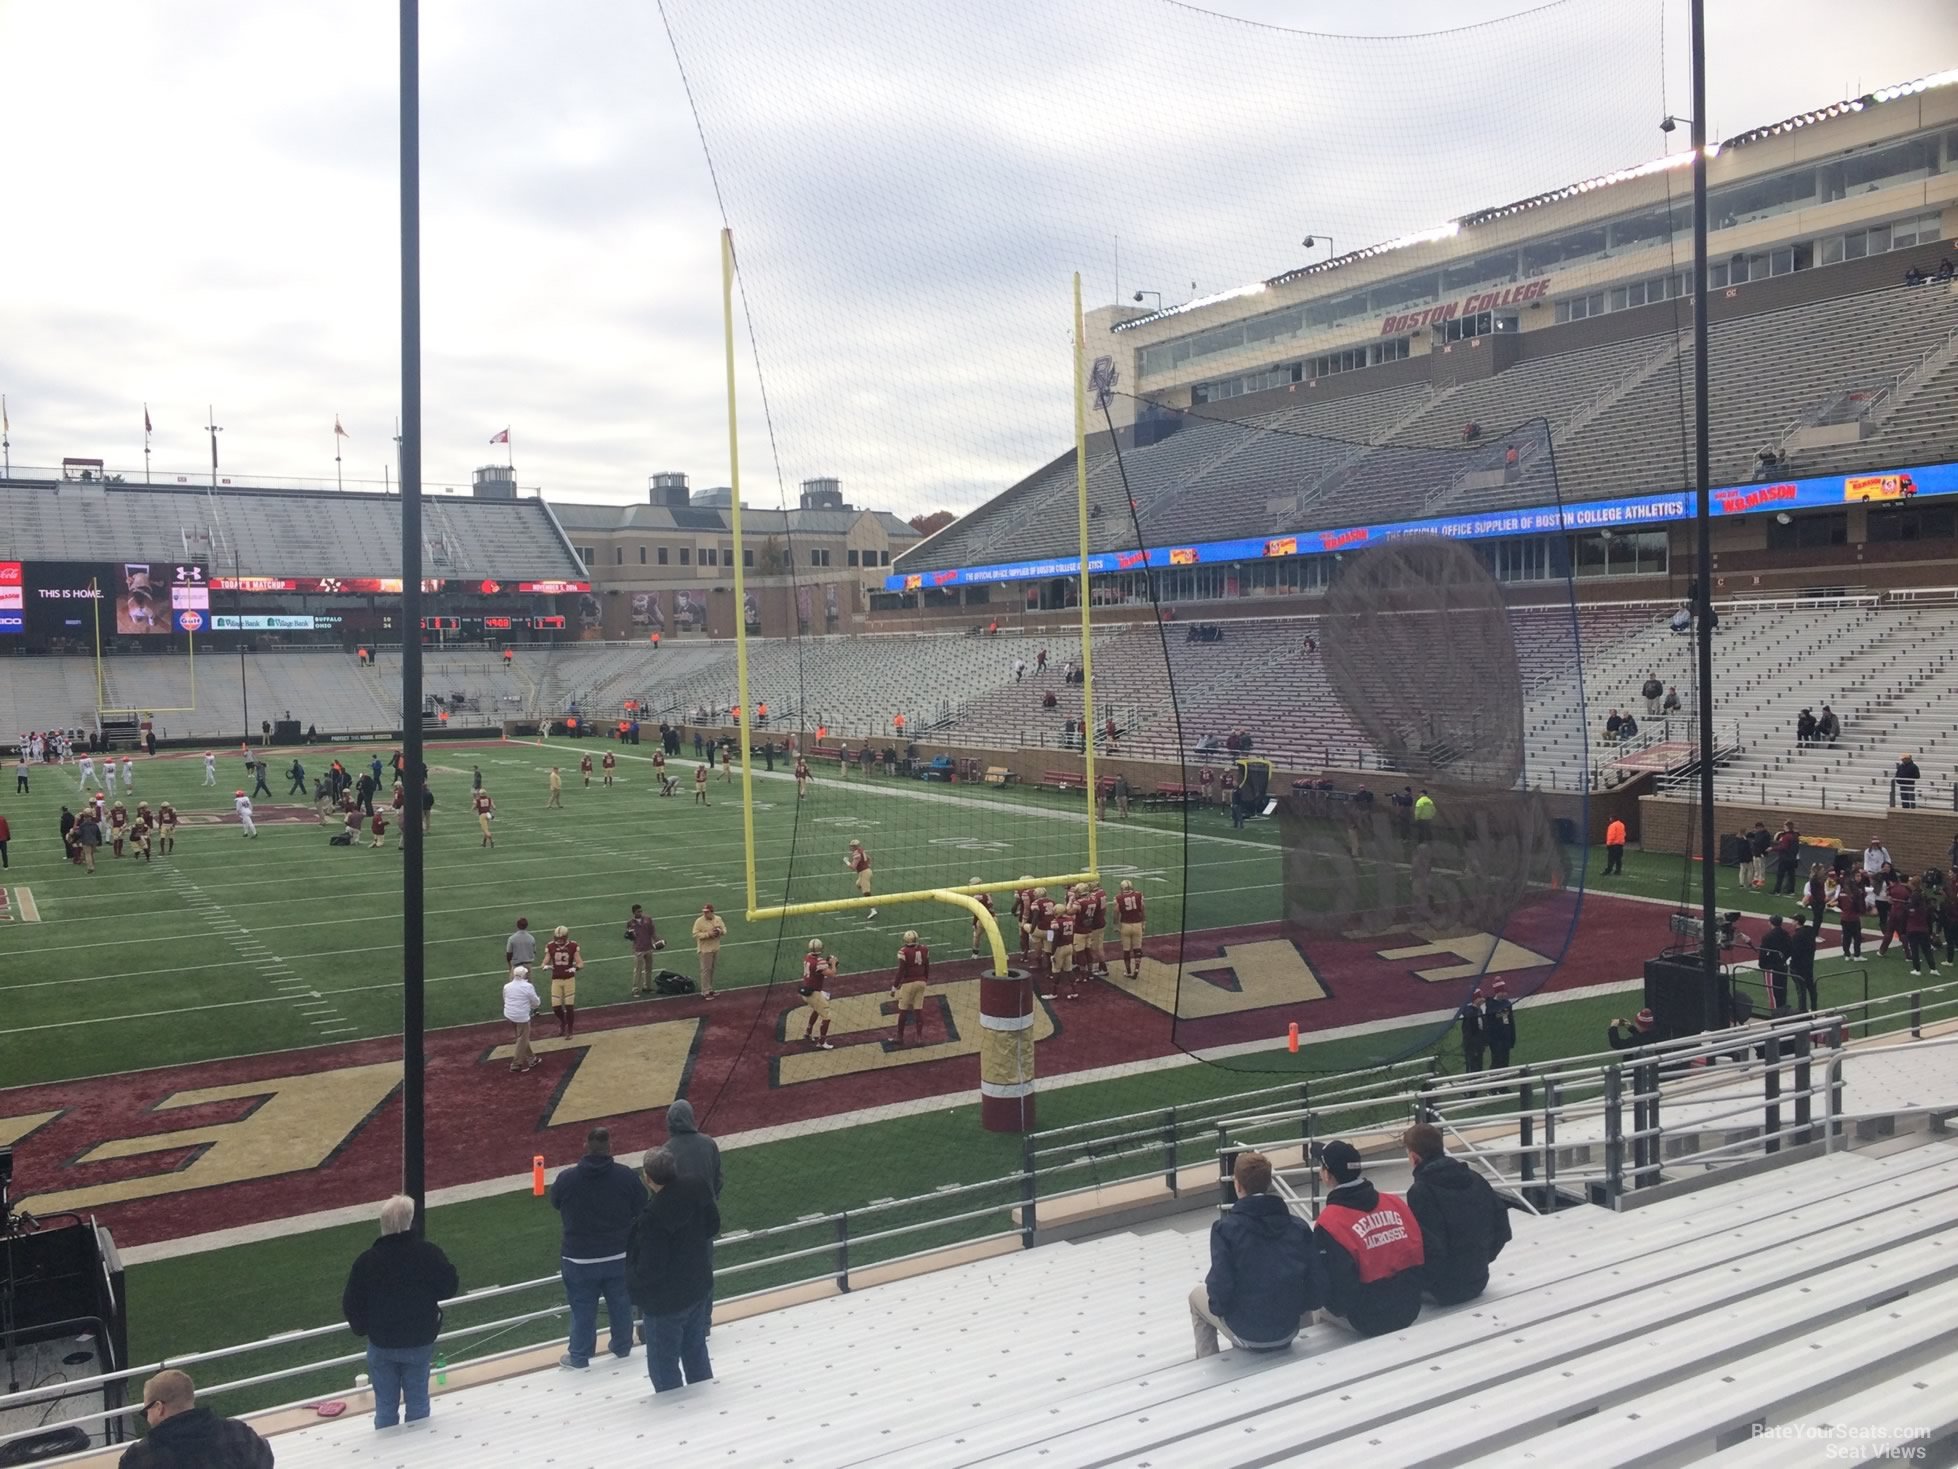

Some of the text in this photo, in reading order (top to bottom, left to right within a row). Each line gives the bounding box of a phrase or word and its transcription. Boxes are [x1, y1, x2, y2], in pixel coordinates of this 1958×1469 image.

[1381, 278, 1552, 336] BOSTON COLLEGE
[1441, 522, 1472, 536] OFFICE
[1475, 517, 1518, 533] SUPPLIER
[1520, 515, 1533, 529] OF
[1536, 511, 1574, 528] BOSTON
[1577, 506, 1622, 524] COLLEGE
[1625, 501, 1683, 519] ATHLETICS
[253, 581, 285, 589] MATCHUP
[38, 589, 104, 599] THIS IS HOME.
[1085, 904, 1097, 917] 47
[1125, 898, 1138, 911] 91
[914, 950, 922, 965] 4
[1352, 1210, 1403, 1239] READING
[1363, 1226, 1408, 1249] LACROSSE
